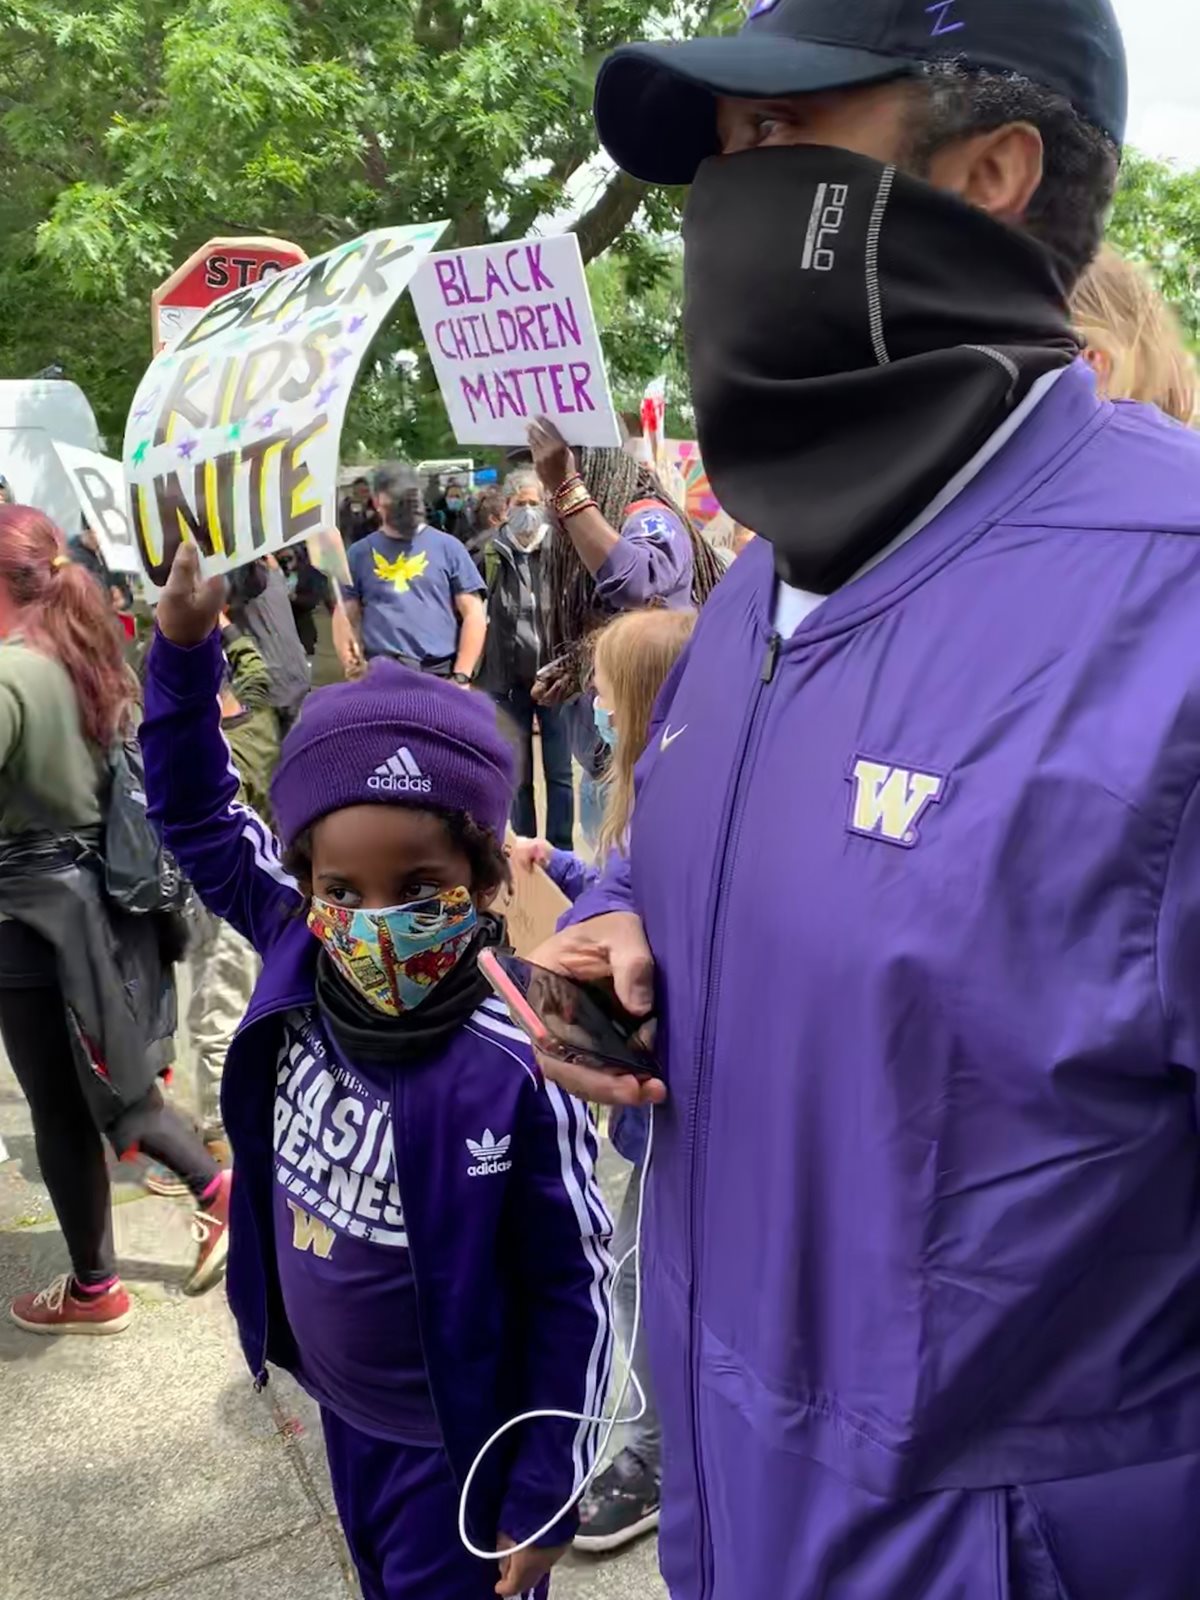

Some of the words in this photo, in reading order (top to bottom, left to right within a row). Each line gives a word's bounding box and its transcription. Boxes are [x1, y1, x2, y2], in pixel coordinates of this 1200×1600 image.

[813, 184, 848, 271] POLO
[174, 238, 414, 352] BLACK
[434, 244, 554, 306] BLACK
[435, 297, 581, 360] CHILDREN
[153, 320, 343, 447] KIDS
[460, 361, 595, 423] MATTER
[367, 774, 432, 792] adidas
[853, 760, 941, 840] W
